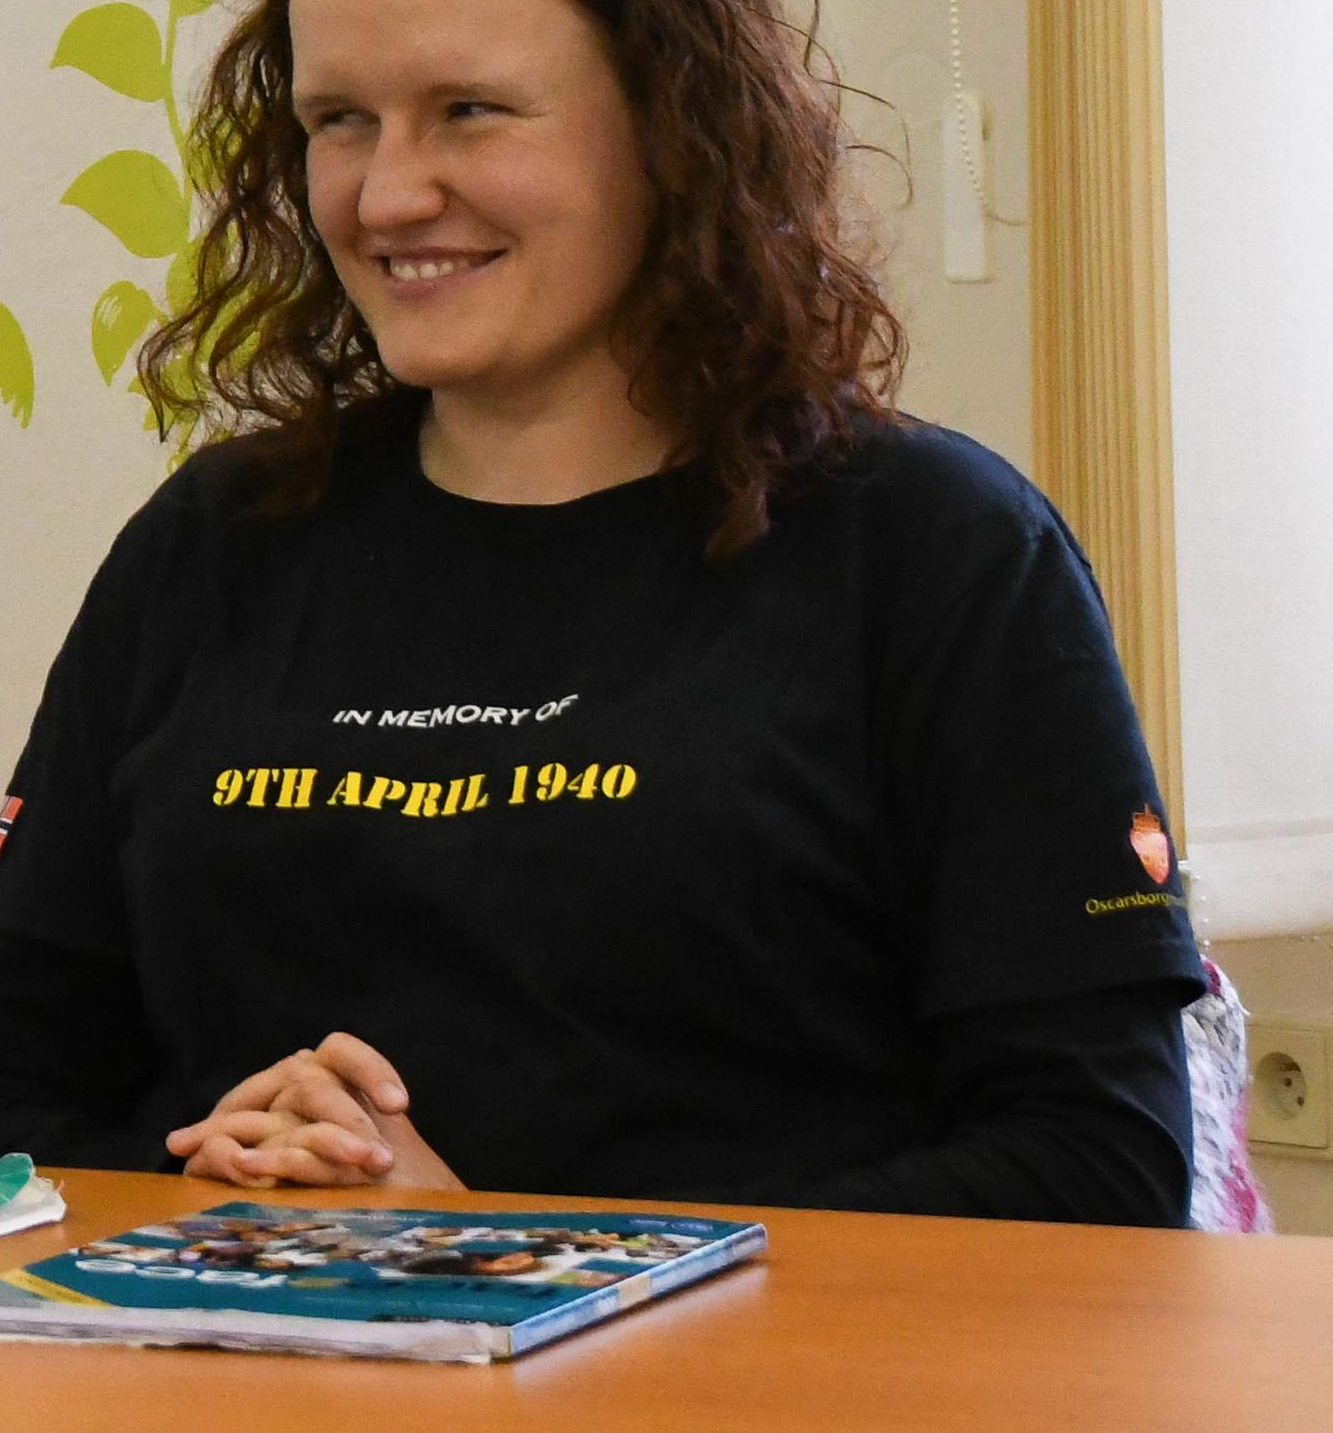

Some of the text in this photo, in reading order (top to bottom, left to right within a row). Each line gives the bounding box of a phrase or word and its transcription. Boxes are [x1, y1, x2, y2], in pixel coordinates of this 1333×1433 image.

[333, 694, 579, 728] IN MEMORY OF
[212, 762, 637, 818] 9TH APRIL 1940
